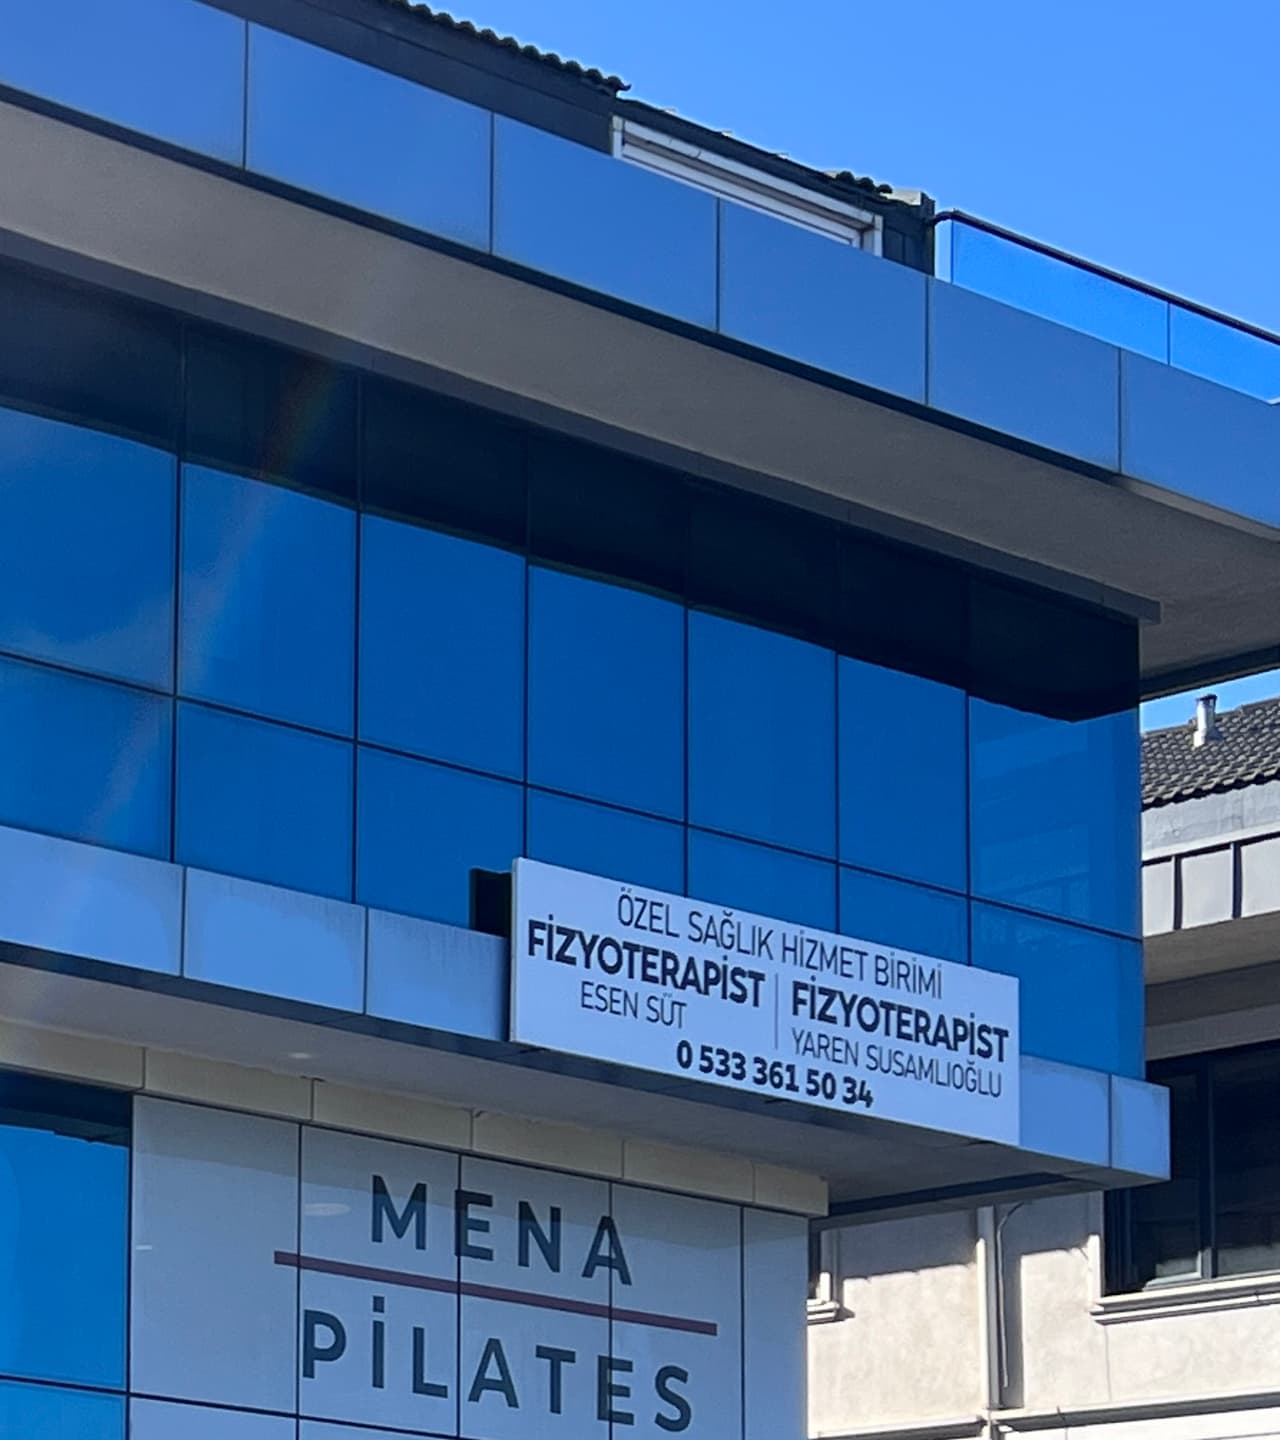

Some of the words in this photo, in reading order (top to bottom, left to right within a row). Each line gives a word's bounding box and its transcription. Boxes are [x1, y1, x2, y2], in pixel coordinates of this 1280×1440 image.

[528, 913, 765, 1008] FİZYOTERAPİST
[618, 886, 680, 938] ÖZEL
[688, 910, 774, 960] SAĞLIK
[781, 929, 868, 981] HİZMET
[874, 951, 943, 1000] BİRİMİ
[580, 980, 638, 1019] ESEN
[646, 992, 687, 1029] SÜT
[792, 975, 1009, 1063] FİZYOTERAPİST
[676, 1040, 693, 1070] 0
[699, 1045, 746, 1082] 533
[752, 1056, 799, 1093] 361
[805, 1068, 837, 1100] 50
[842, 1076, 874, 1108] 34
[792, 1027, 859, 1067] YAREN
[866, 1044, 1002, 1098] SUSAMLIOĞLU
[371, 1174, 633, 1286] MENA
[302, 1295, 692, 1433] PİLATES
